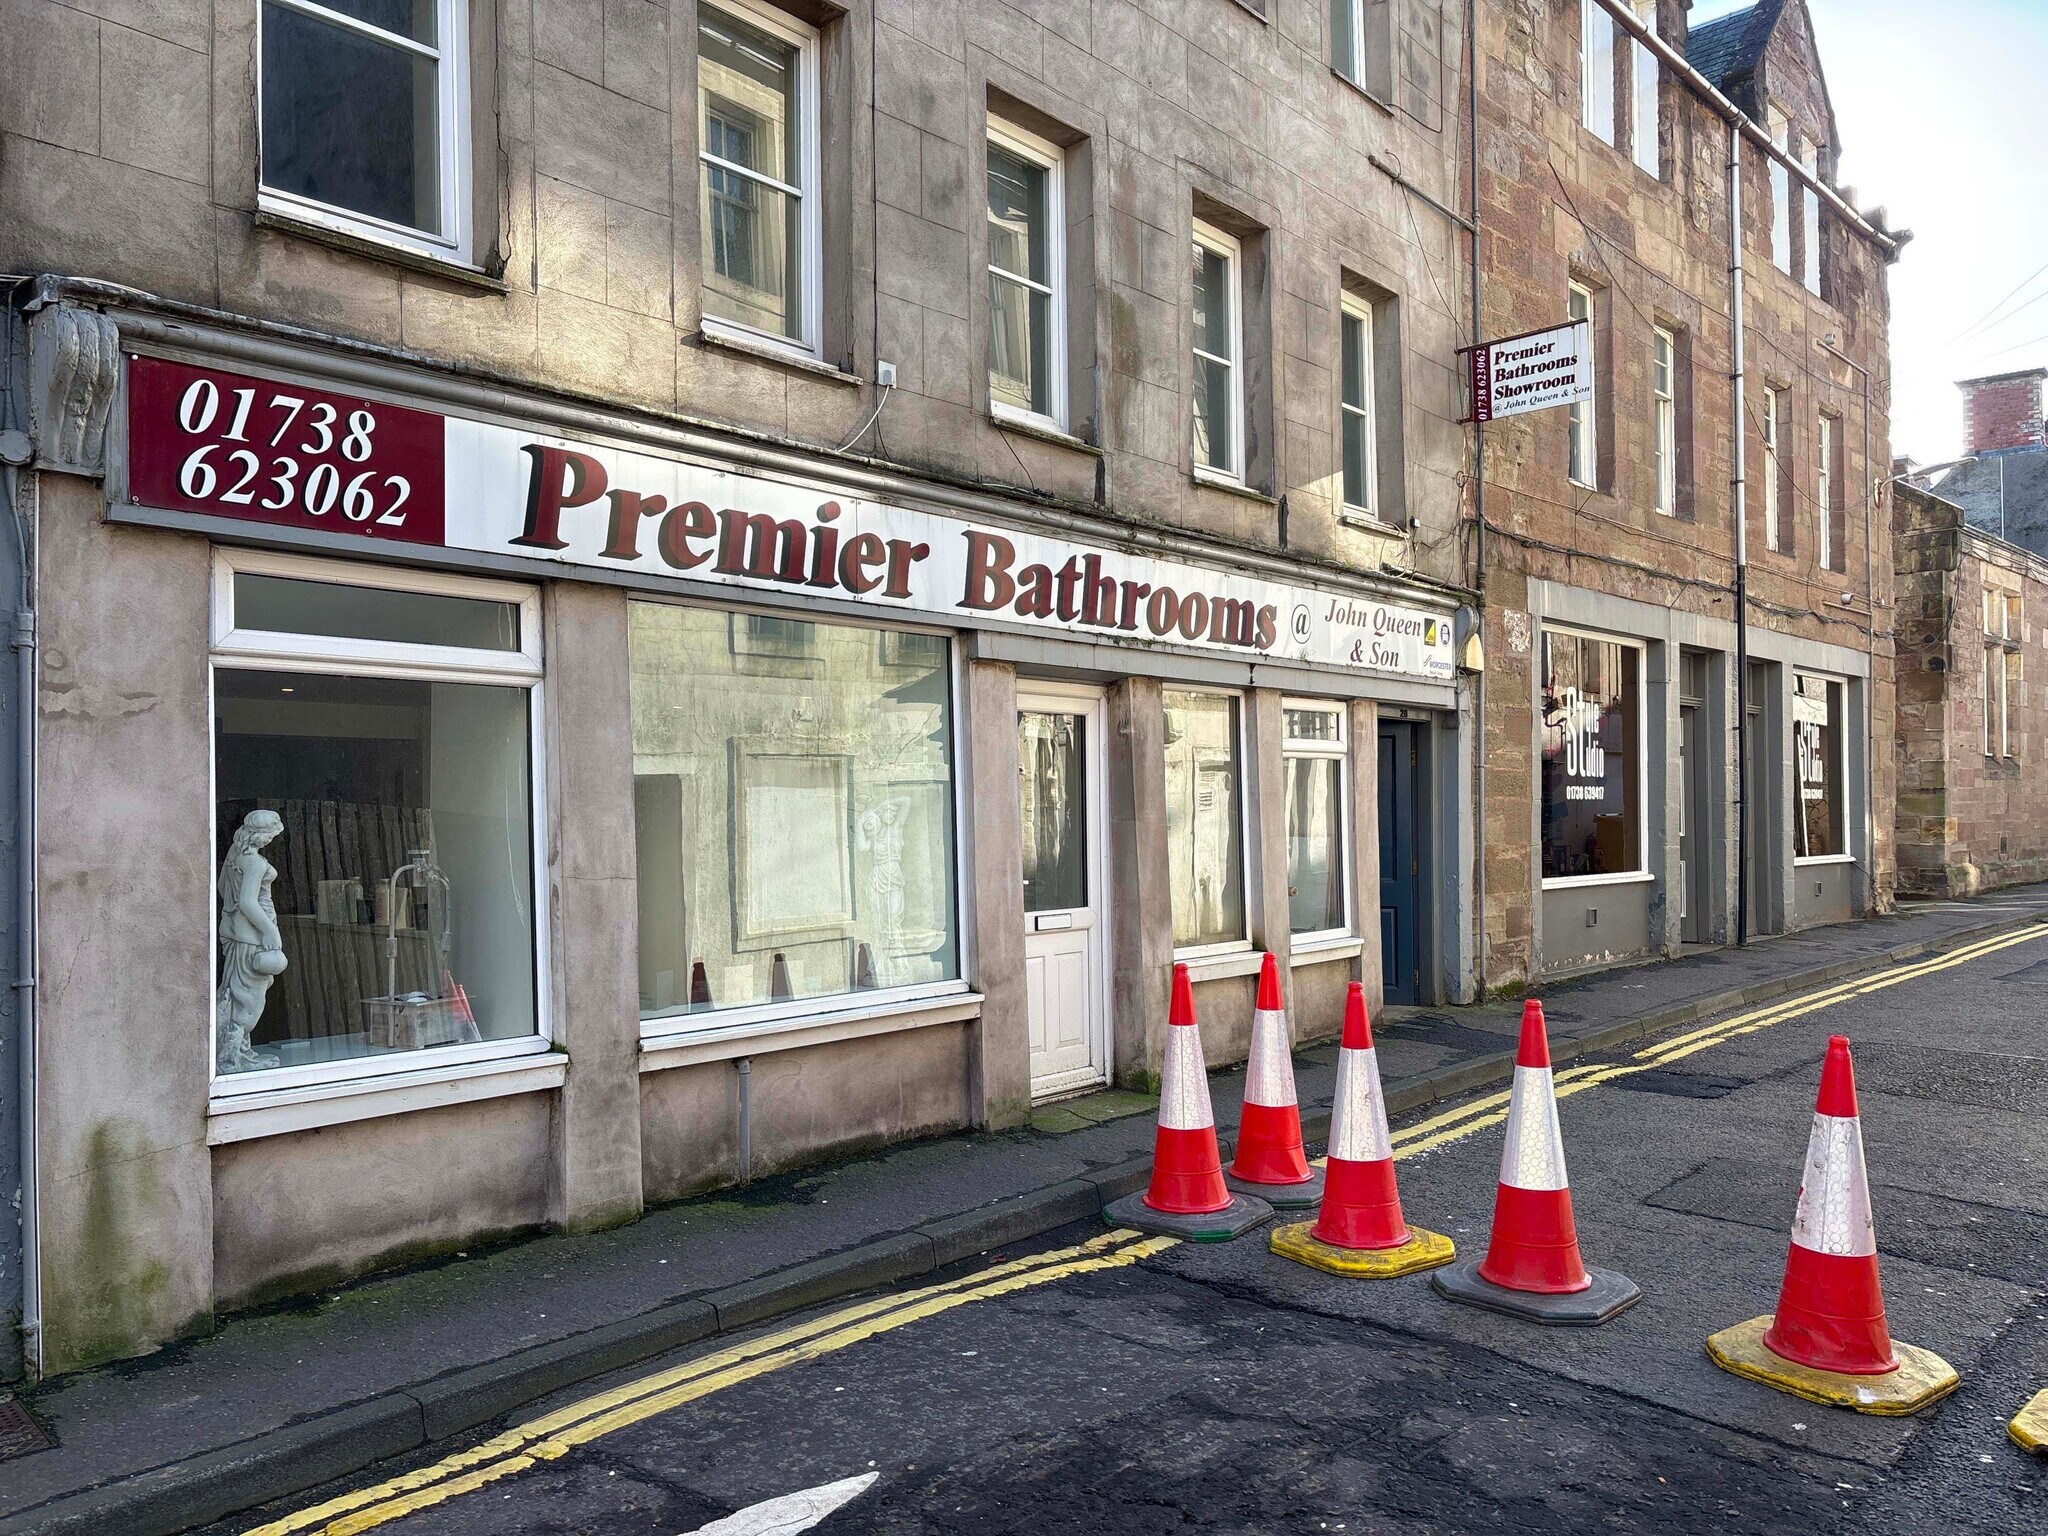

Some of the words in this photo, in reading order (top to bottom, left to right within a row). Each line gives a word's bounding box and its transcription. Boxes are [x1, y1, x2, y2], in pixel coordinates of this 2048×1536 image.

[1476, 350, 1486, 386] 623062
[1494, 342, 1555, 365] Premier
[1494, 355, 1577, 382] Bathrooms
[1493, 403, 1502, 413] @
[1504, 400, 1526, 410] John
[1529, 393, 1558, 405] Queen
[1561, 389, 1569, 397] &
[1572, 386, 1590, 396] Son
[1494, 373, 1575, 400] Showroom
[1478, 389, 1487, 420] 01738
[177, 379, 376, 462] 01738
[177, 445, 411, 526] 623062
[507, 443, 929, 599] Premier
[956, 530, 1277, 650] Bathrooms
[1291, 604, 1312, 644] @
[1325, 599, 1367, 628] John
[1373, 608, 1421, 637] Queen
[1350, 639, 1364, 662] &
[1370, 642, 1399, 667] Son
[1566, 785, 1583, 800] 01738
